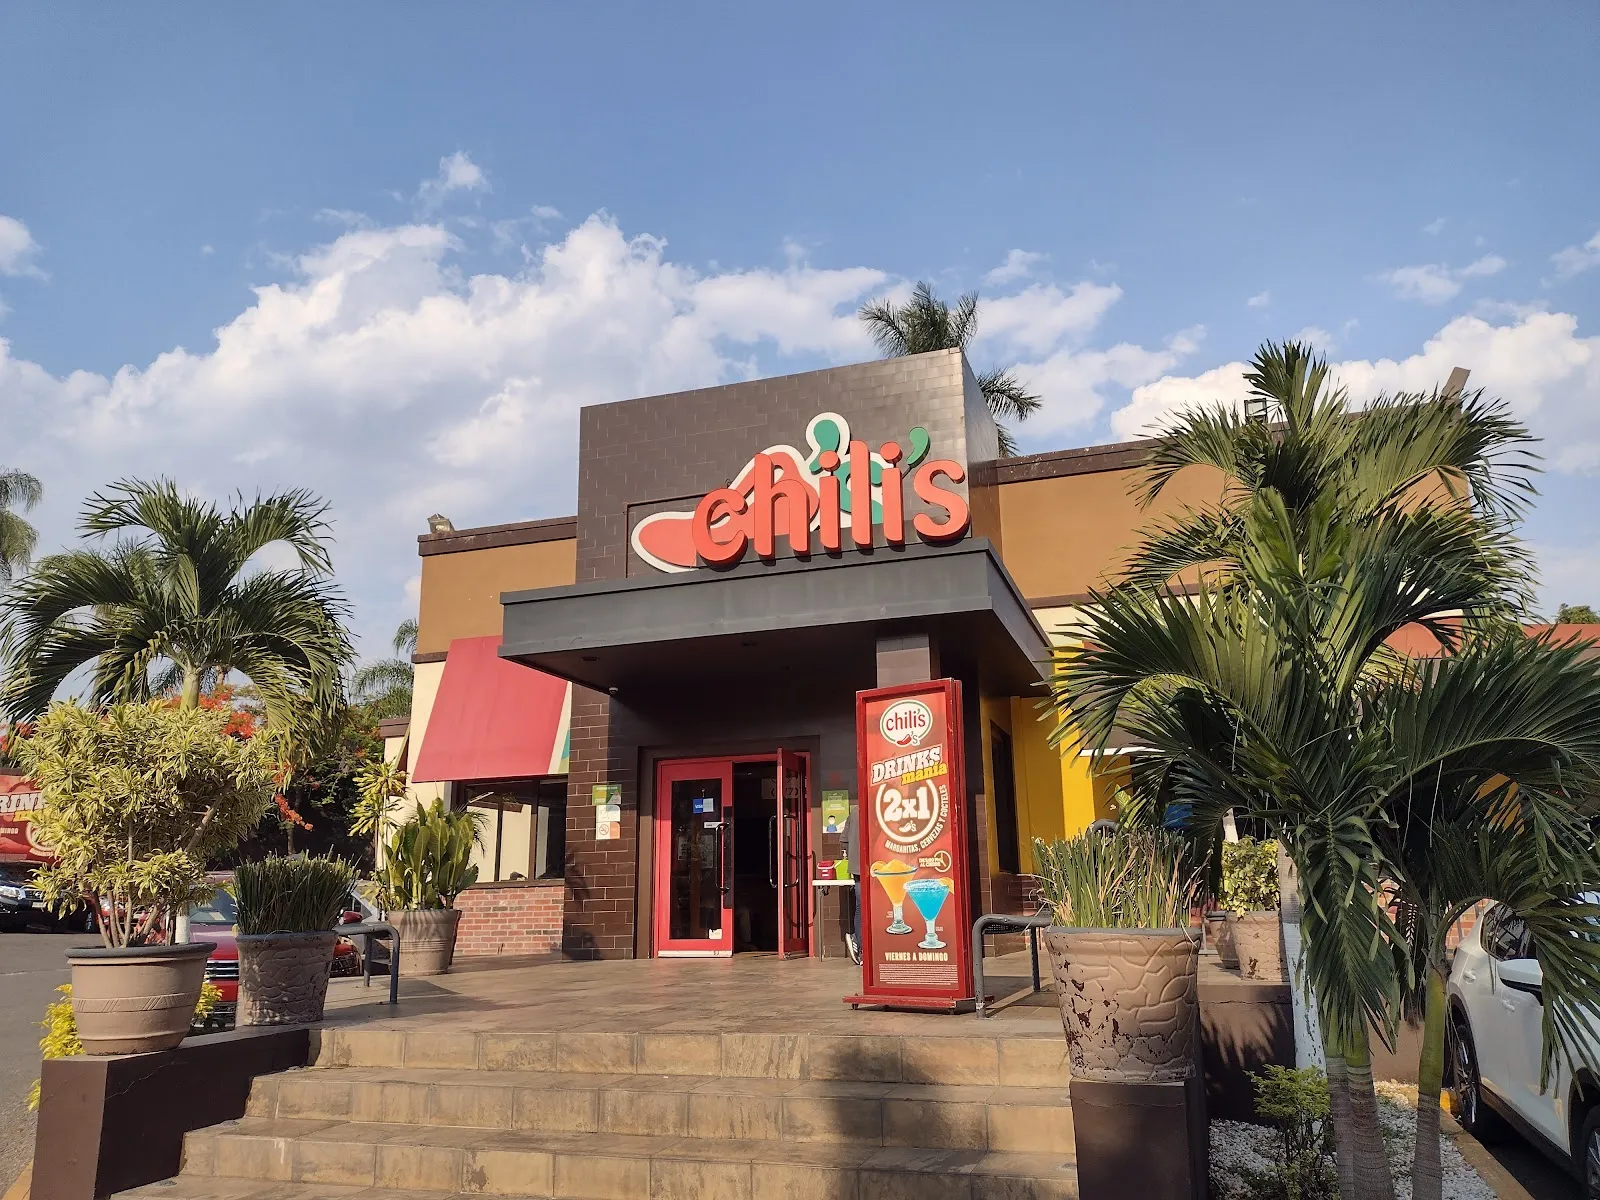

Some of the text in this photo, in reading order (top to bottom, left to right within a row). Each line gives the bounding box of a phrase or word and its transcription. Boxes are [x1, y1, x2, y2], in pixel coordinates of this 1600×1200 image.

[692, 426, 970, 563] chili's
[886, 708, 926, 731] chili's
[872, 746, 941, 784] DRINKS
[883, 786, 931, 822] 2x1
[0, 827, 19, 835] MINGO
[884, 839, 921, 854] MARGARITAS,
[919, 822, 944, 849] CERVEZAS
[884, 952, 948, 961] VIERNES A DOMINGO
